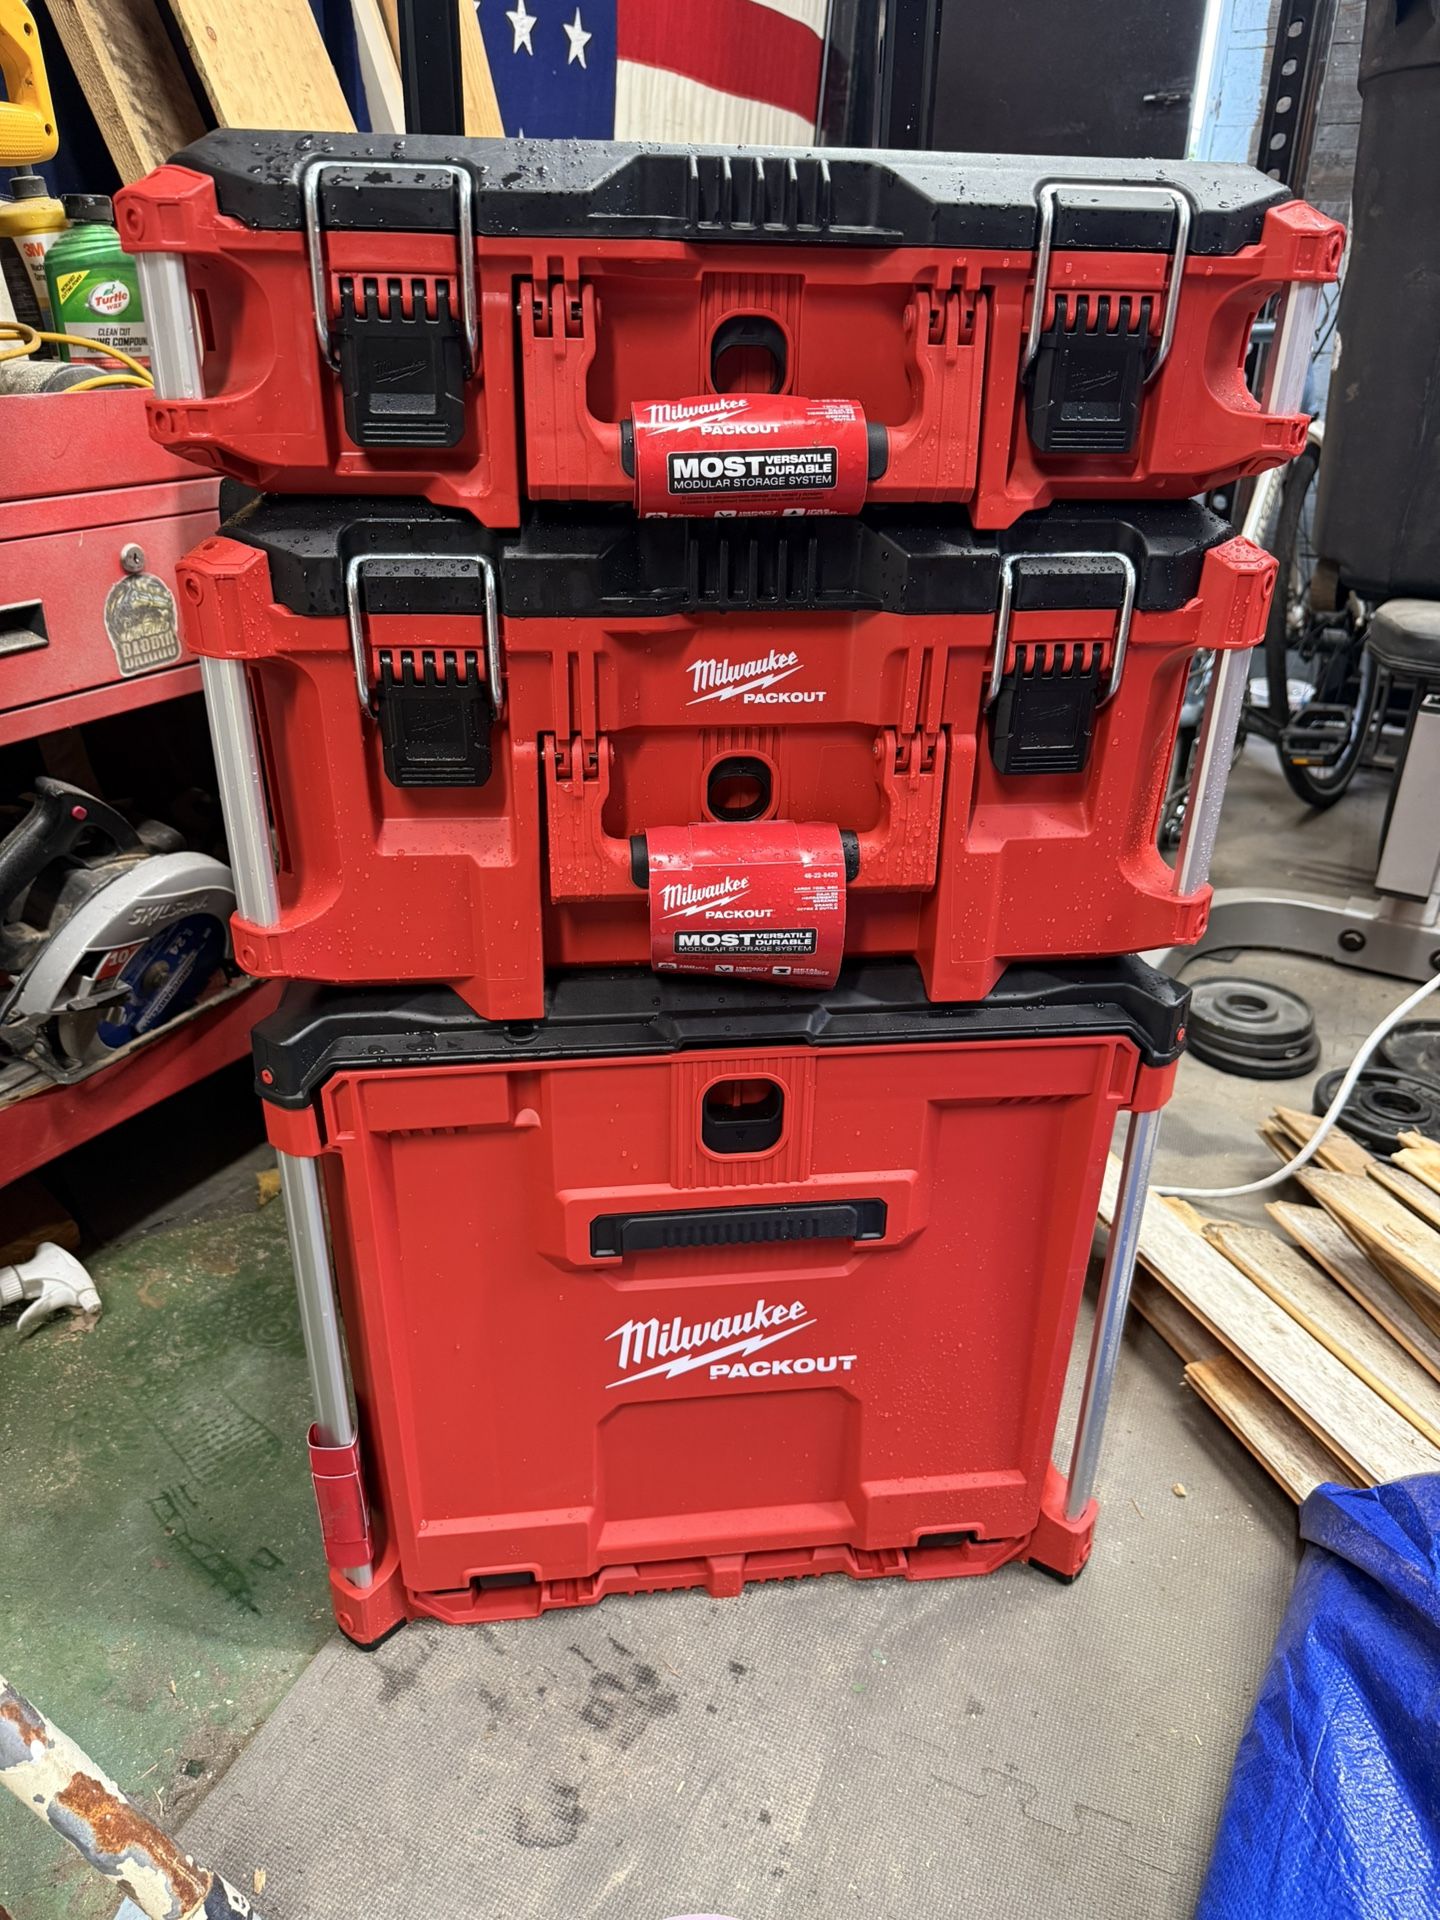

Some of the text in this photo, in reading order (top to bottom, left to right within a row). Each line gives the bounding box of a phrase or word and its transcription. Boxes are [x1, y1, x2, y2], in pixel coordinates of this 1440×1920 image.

[23, 242, 45, 257] 3M
[95, 291, 128, 306] Turtle
[98, 328, 131, 336] CLEAN CUT
[643, 398, 750, 426] Milwaukee
[701, 424, 781, 435] PACKOUT
[673, 453, 832, 479] MOST VERSATILE
[765, 464, 832, 475] DURABLE
[674, 475, 832, 489] MODULAR STORAGE SYSTEM
[685, 649, 799, 693] Milwaukee
[743, 692, 826, 704] PACKOUT
[658, 876, 751, 911] Milwaukee
[705, 909, 773, 919] PACKOUT
[678, 933, 755, 946] MOST
[605, 1299, 808, 1370] Milwaukee
[709, 1355, 857, 1380] PACKOUT
